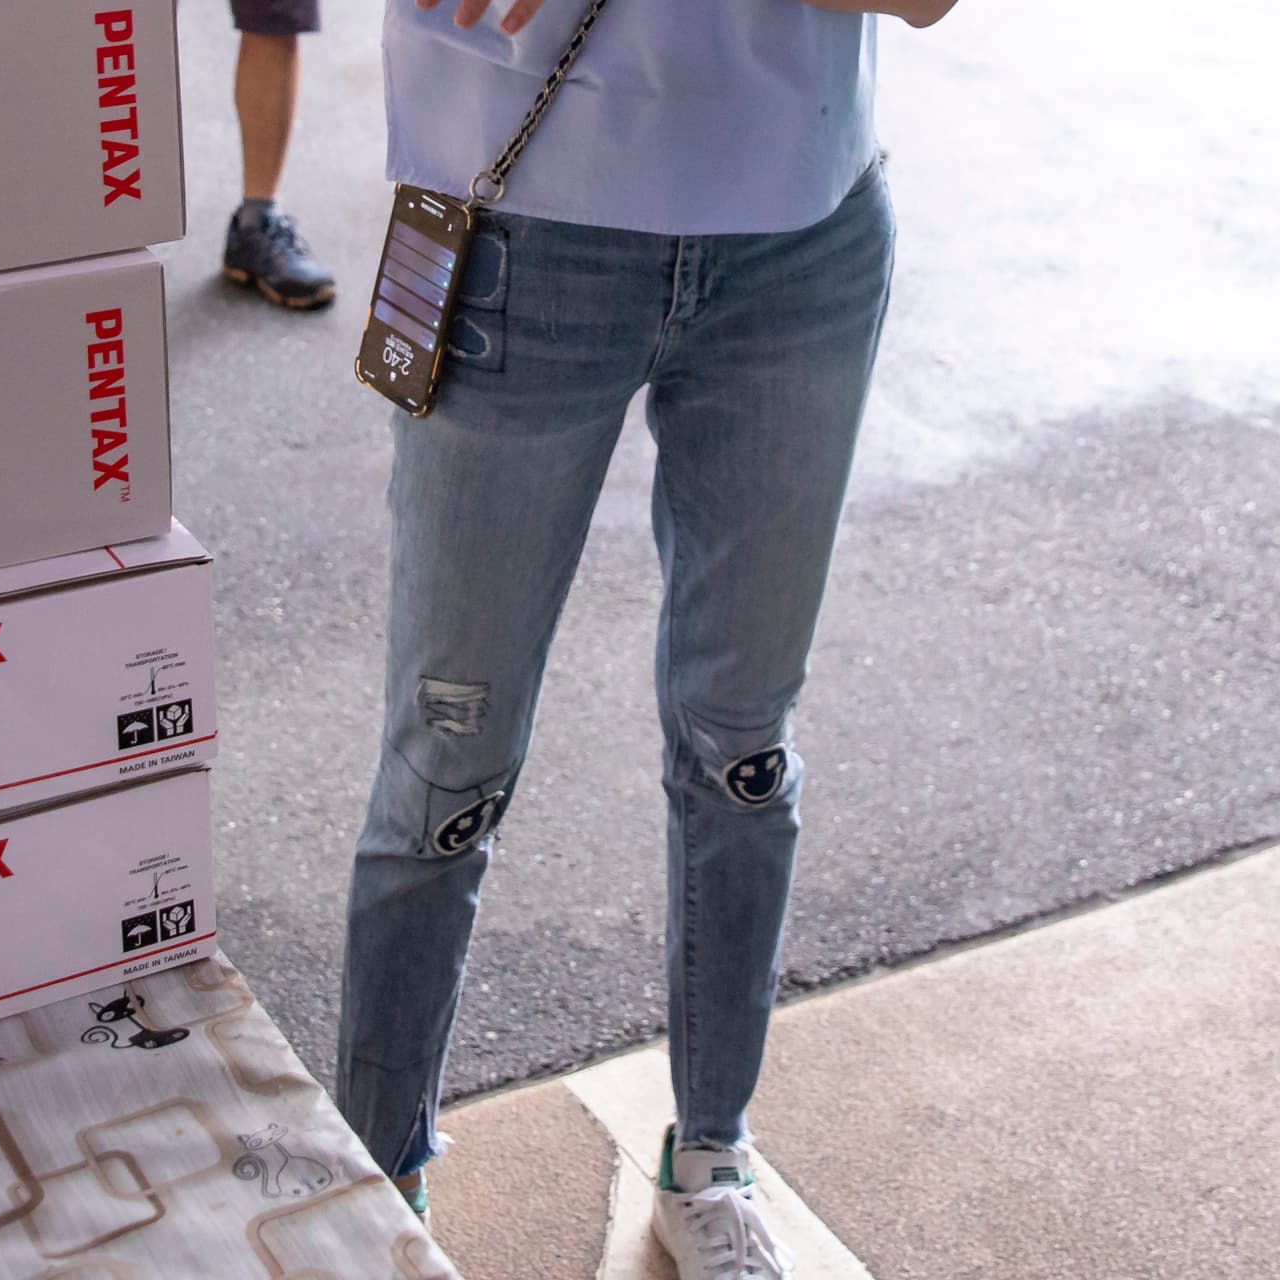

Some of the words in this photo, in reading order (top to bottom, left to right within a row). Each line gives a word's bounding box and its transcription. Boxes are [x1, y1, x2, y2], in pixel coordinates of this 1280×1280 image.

[94, 9, 142, 208] PENTAX
[381, 346, 413, 376] 2:40
[85, 307, 129, 491] PENTAX
[120, 762, 147, 774] MADE
[148, 759, 158, 768] IN
[161, 749, 196, 764] TAIWAN
[123, 963, 150, 975] MADE
[151, 960, 161, 968] IN
[163, 947, 198, 963] TAIWAN
